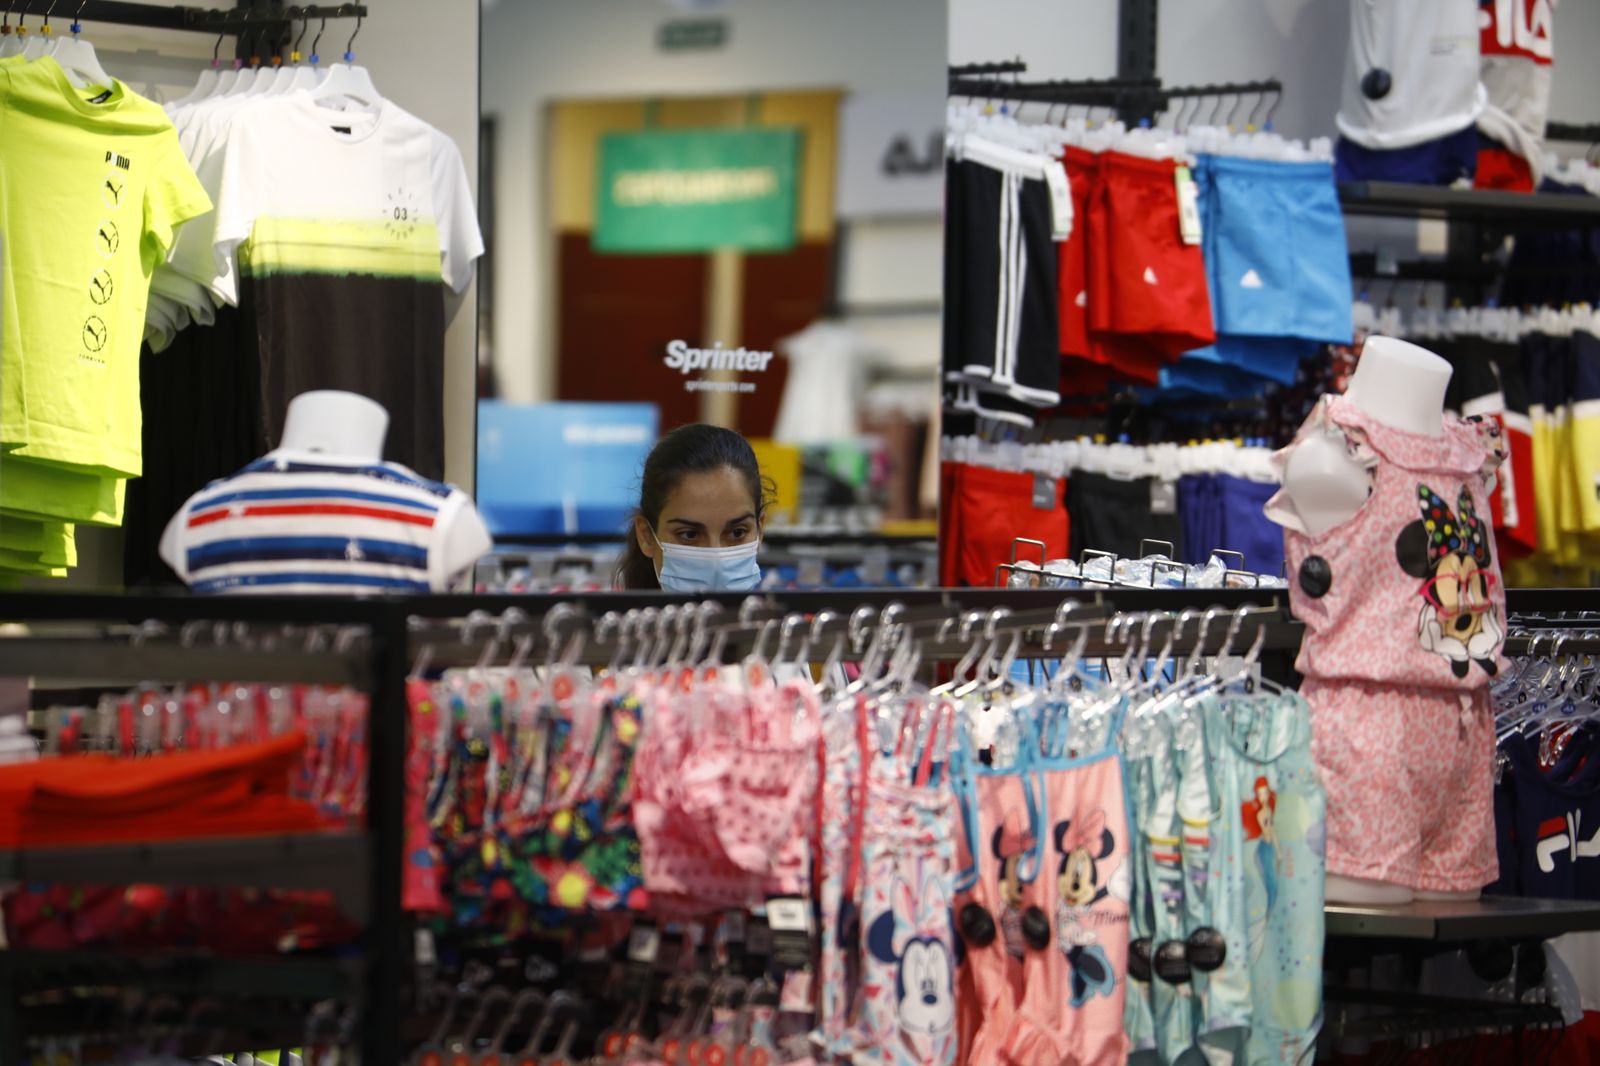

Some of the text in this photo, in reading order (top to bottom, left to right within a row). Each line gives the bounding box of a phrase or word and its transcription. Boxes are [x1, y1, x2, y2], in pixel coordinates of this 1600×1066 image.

[1478, 0, 1553, 58] ILA
[394, 206, 407, 221] 03
[664, 339, 774, 374] Sprinter
